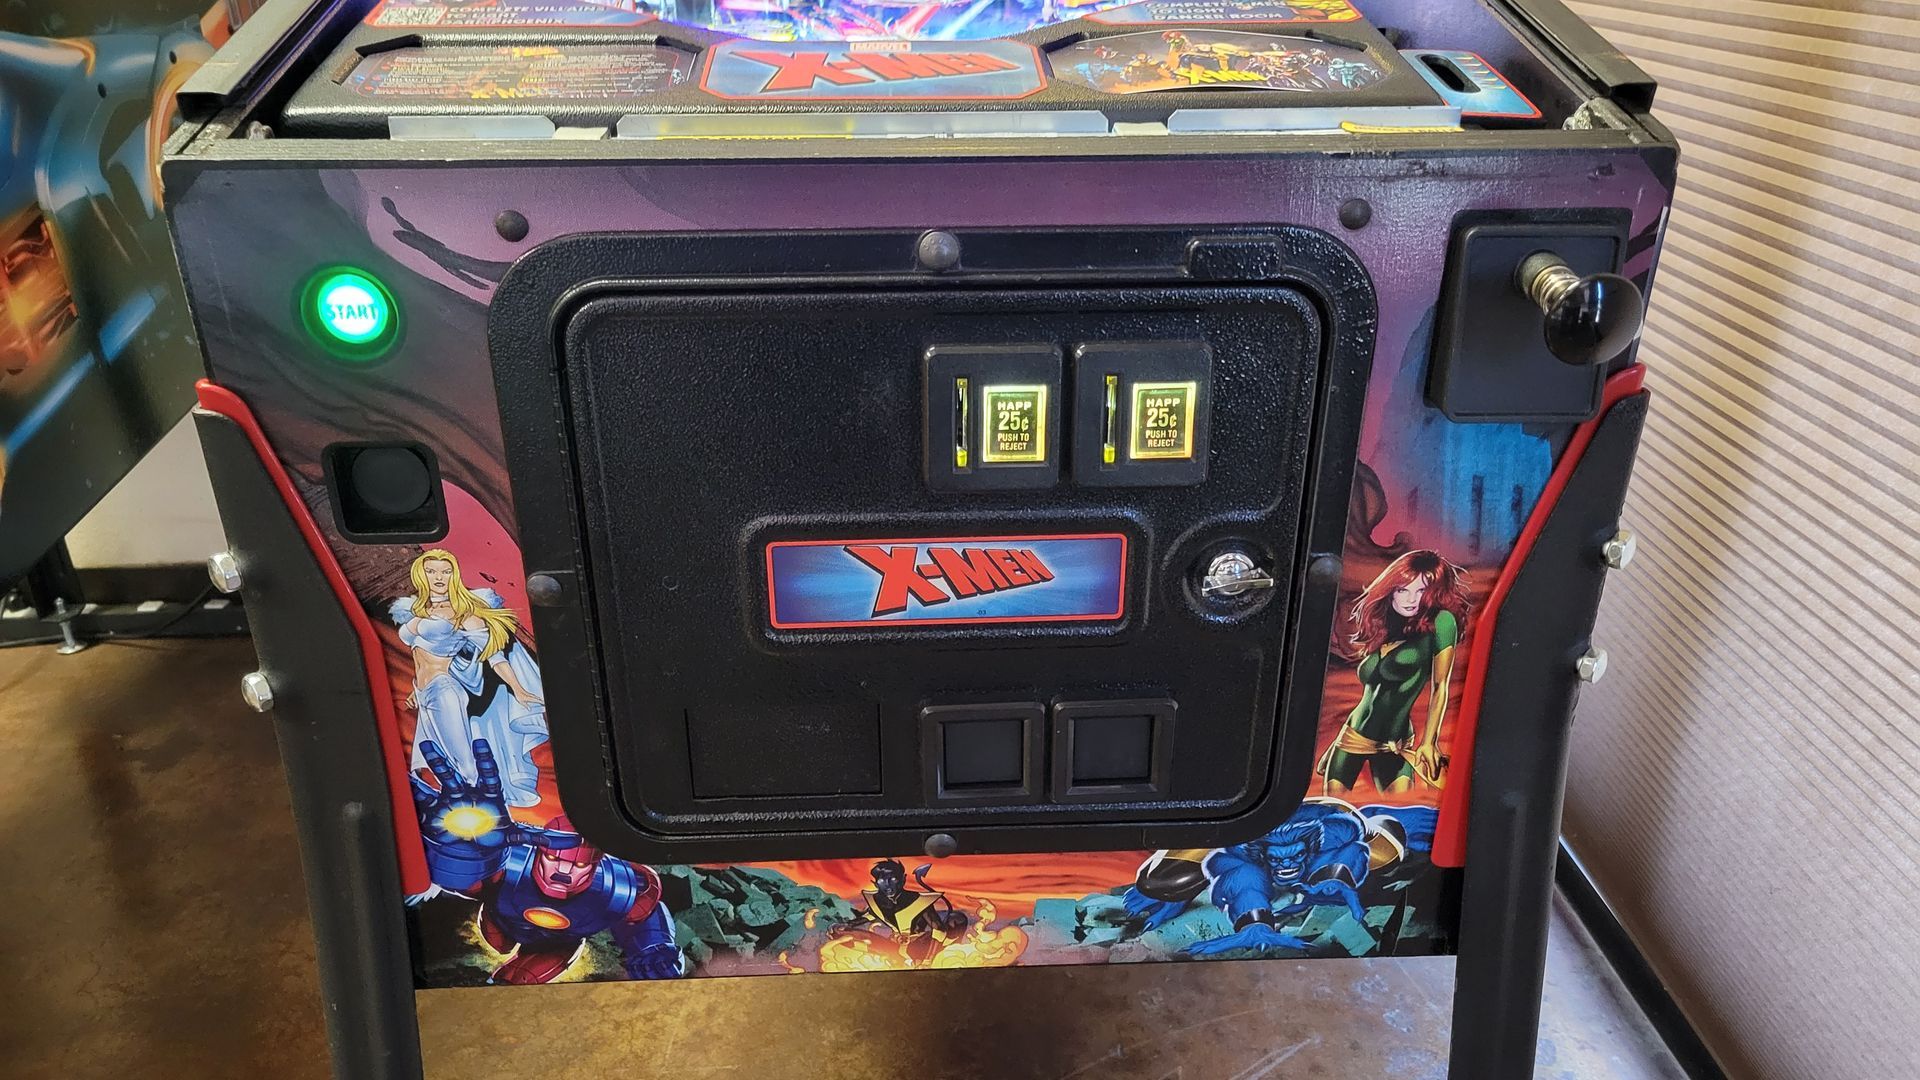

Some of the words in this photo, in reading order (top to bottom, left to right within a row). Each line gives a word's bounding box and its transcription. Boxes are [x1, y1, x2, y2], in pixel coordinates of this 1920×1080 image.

[729, 51, 1022, 94] X-MEN
[326, 304, 379, 321] START
[997, 401, 1032, 411] HAPP
[1146, 397, 1181, 408] HAPP
[998, 411, 1030, 432] 25¢
[1146, 408, 1178, 429] 25¢
[997, 432, 1020, 442] PUSH
[1020, 432, 1030, 442] TO
[1145, 429, 1167, 440] PUSH
[1168, 429, 1178, 439] TO
[1000, 441, 1028, 451] REJECT
[1147, 438, 1175, 449] REJECT
[842, 545, 1056, 618] X-MEN
